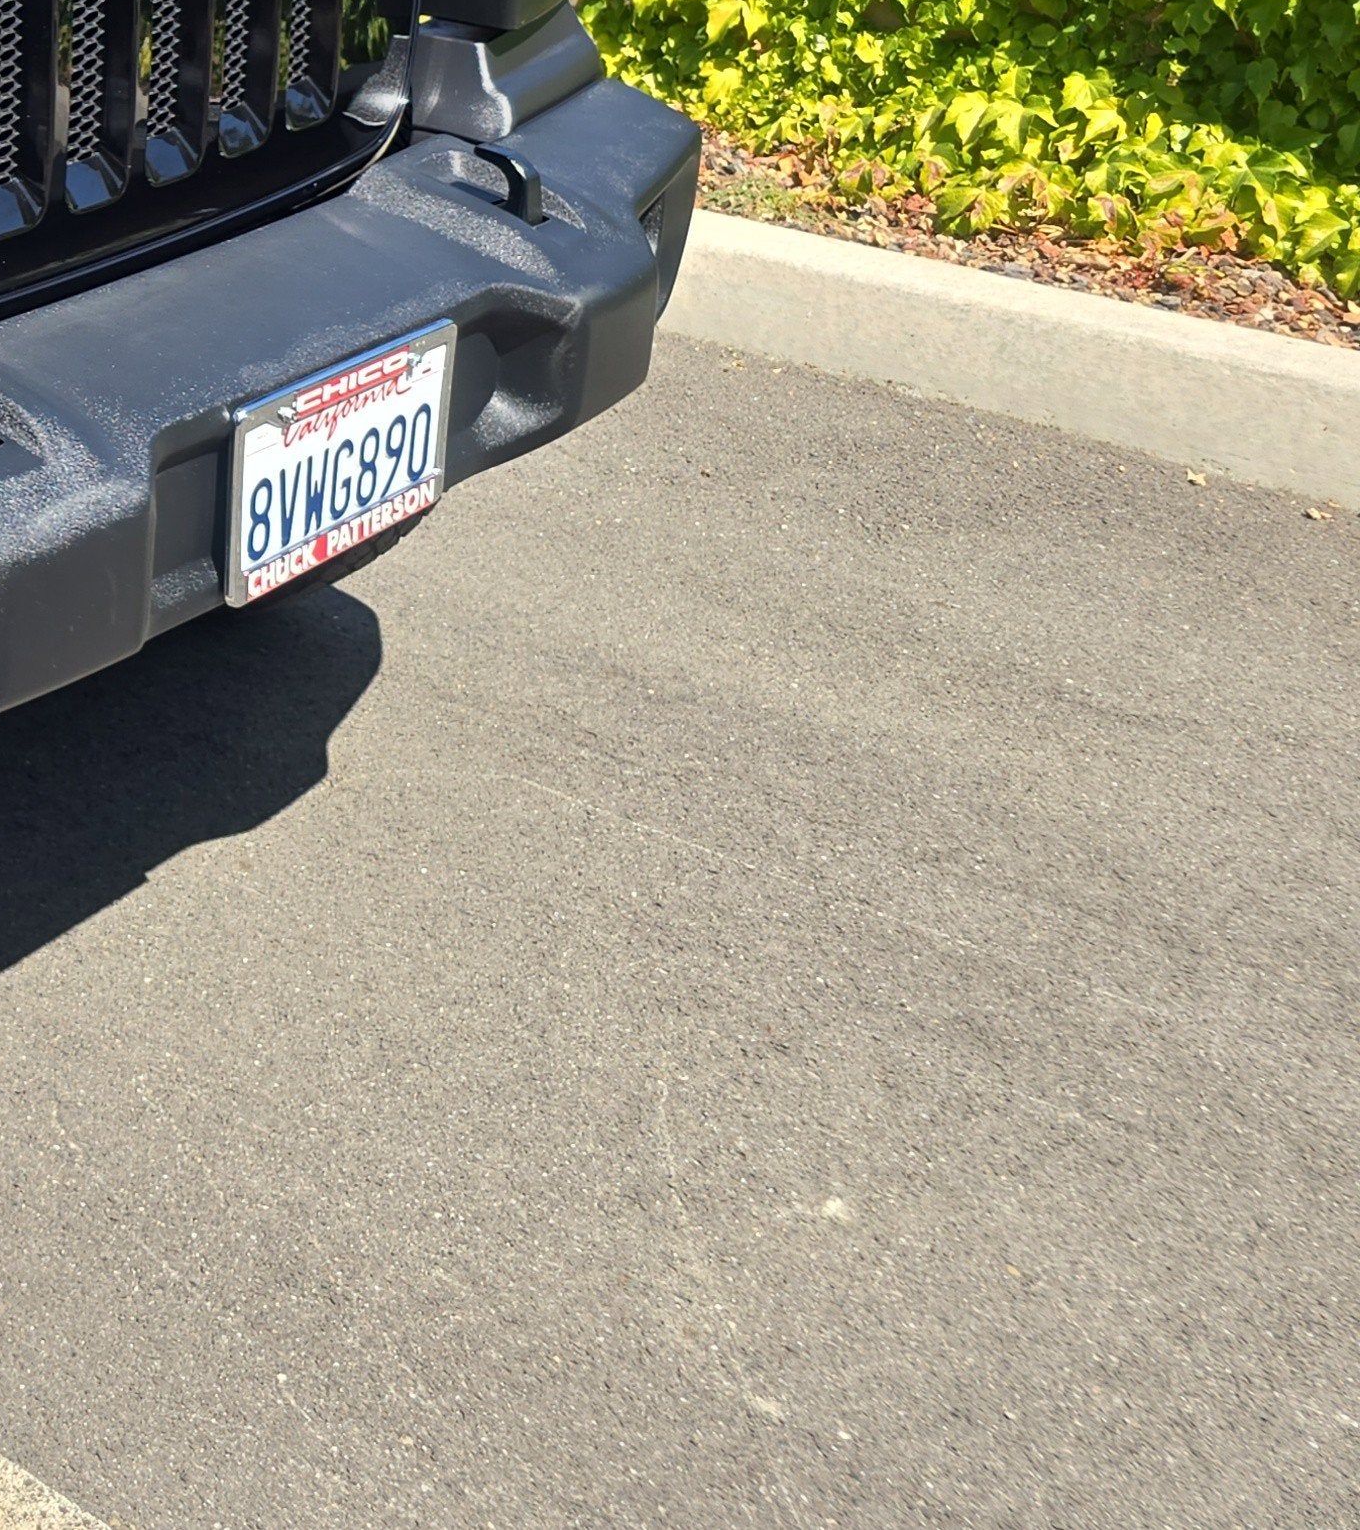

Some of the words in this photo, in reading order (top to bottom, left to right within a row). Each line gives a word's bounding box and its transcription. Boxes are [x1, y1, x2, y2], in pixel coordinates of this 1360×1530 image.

[284, 374, 412, 447] California
[296, 350, 408, 414] CHICO
[246, 402, 432, 561] 8VWG890
[247, 539, 318, 598] CHUCK
[326, 479, 435, 557] PATTERSON
